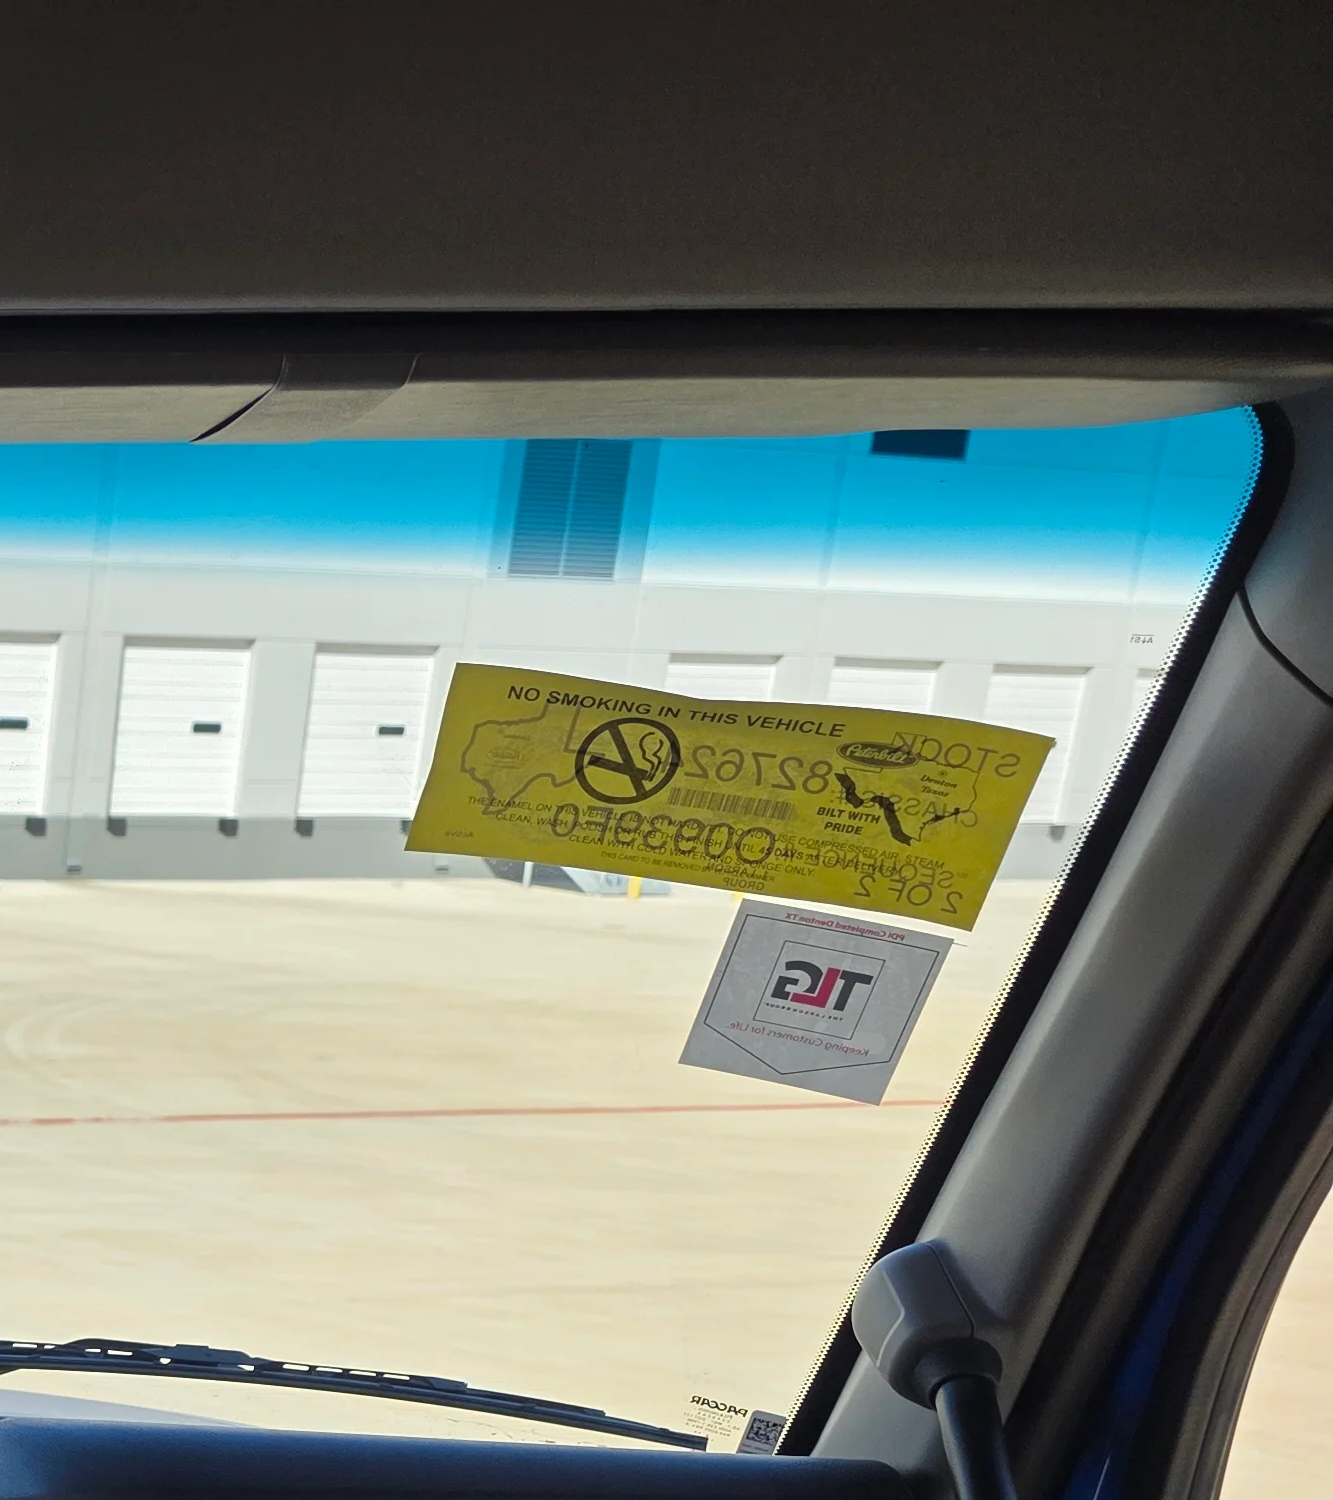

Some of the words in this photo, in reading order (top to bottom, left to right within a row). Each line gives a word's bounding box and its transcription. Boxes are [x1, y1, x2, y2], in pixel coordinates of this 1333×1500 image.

[507, 685, 541, 702] NO
[546, 691, 652, 716] SMOKING
[657, 704, 681, 719] IN
[688, 709, 738, 726] THIS
[746, 714, 846, 738] VEHICLE
[844, 743, 914, 766] Peterbilt
[919, 774, 958, 789] Denton
[919, 785, 951, 798] Texas
[816, 806, 846, 820] BILT
[847, 810, 881, 824] WITH
[467, 795, 490, 805] THE
[490, 798, 533, 811] ENAMEL
[536, 803, 552, 812] ON
[555, 804, 579, 815] THIS
[582, 806, 627, 821] VEHICLE
[774, 834, 795, 845] USE
[799, 837, 877, 858] COMPRESSED
[905, 854, 945, 870] STEAM
[823, 821, 863, 836] PRIDE
[574, 821, 612, 834] POLISH
[773, 847, 804, 860] DAYS
[569, 835, 603, 847] CLEAN
[607, 838, 633, 850] WITH
[636, 842, 666, 855] COLD
[670, 847, 706, 860] WATER
[735, 857, 781, 872] SPONGE
